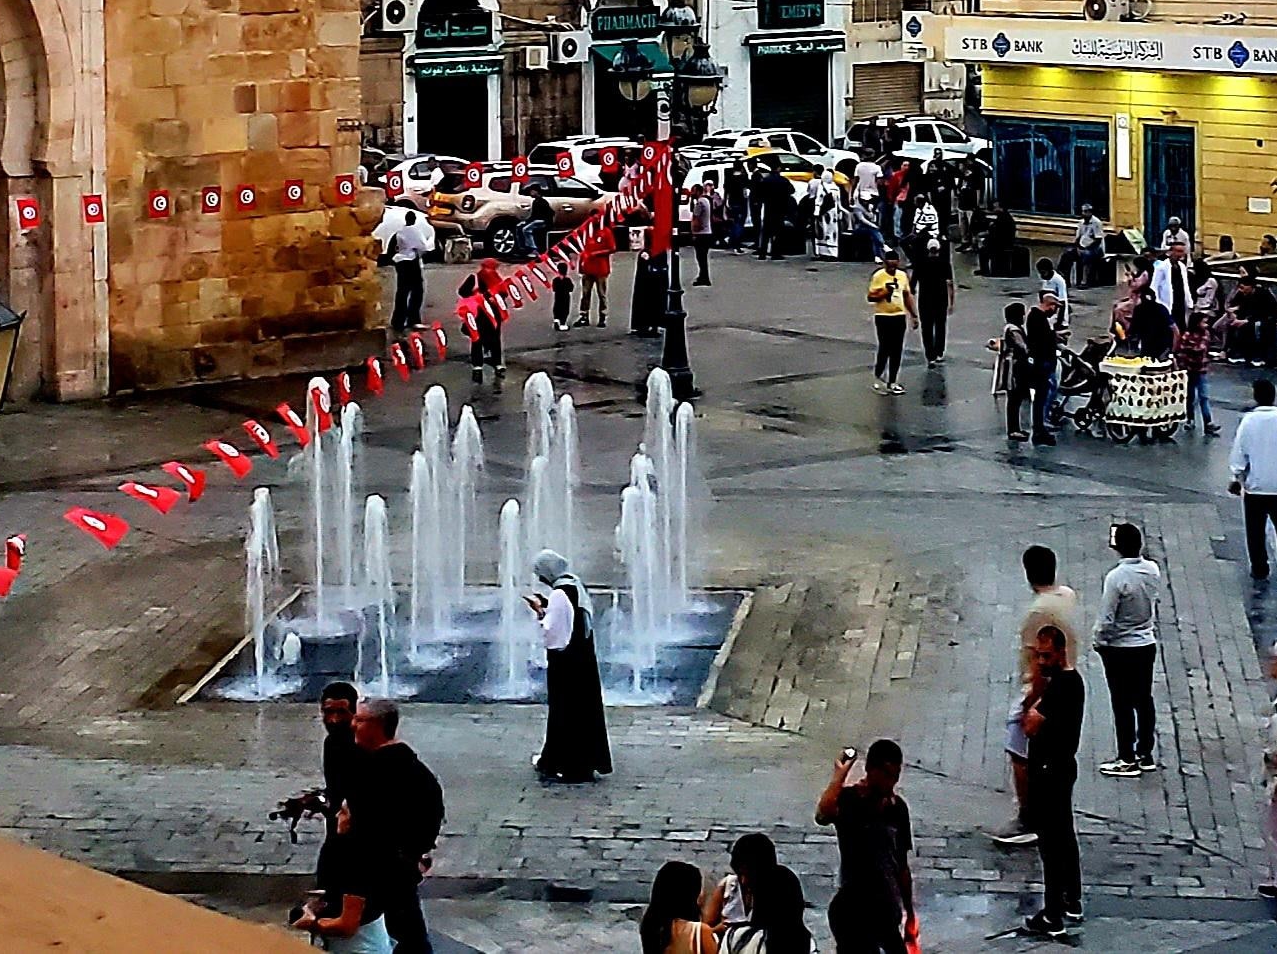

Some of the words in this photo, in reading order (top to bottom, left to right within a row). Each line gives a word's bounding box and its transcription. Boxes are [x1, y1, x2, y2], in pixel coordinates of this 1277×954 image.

[424, 19, 487, 40] صيدلية
[962, 38, 988, 50] STB
[1013, 40, 1044, 53] BANK
[1135, 40, 1164, 61] الشركة
[1192, 46, 1223, 60] STB
